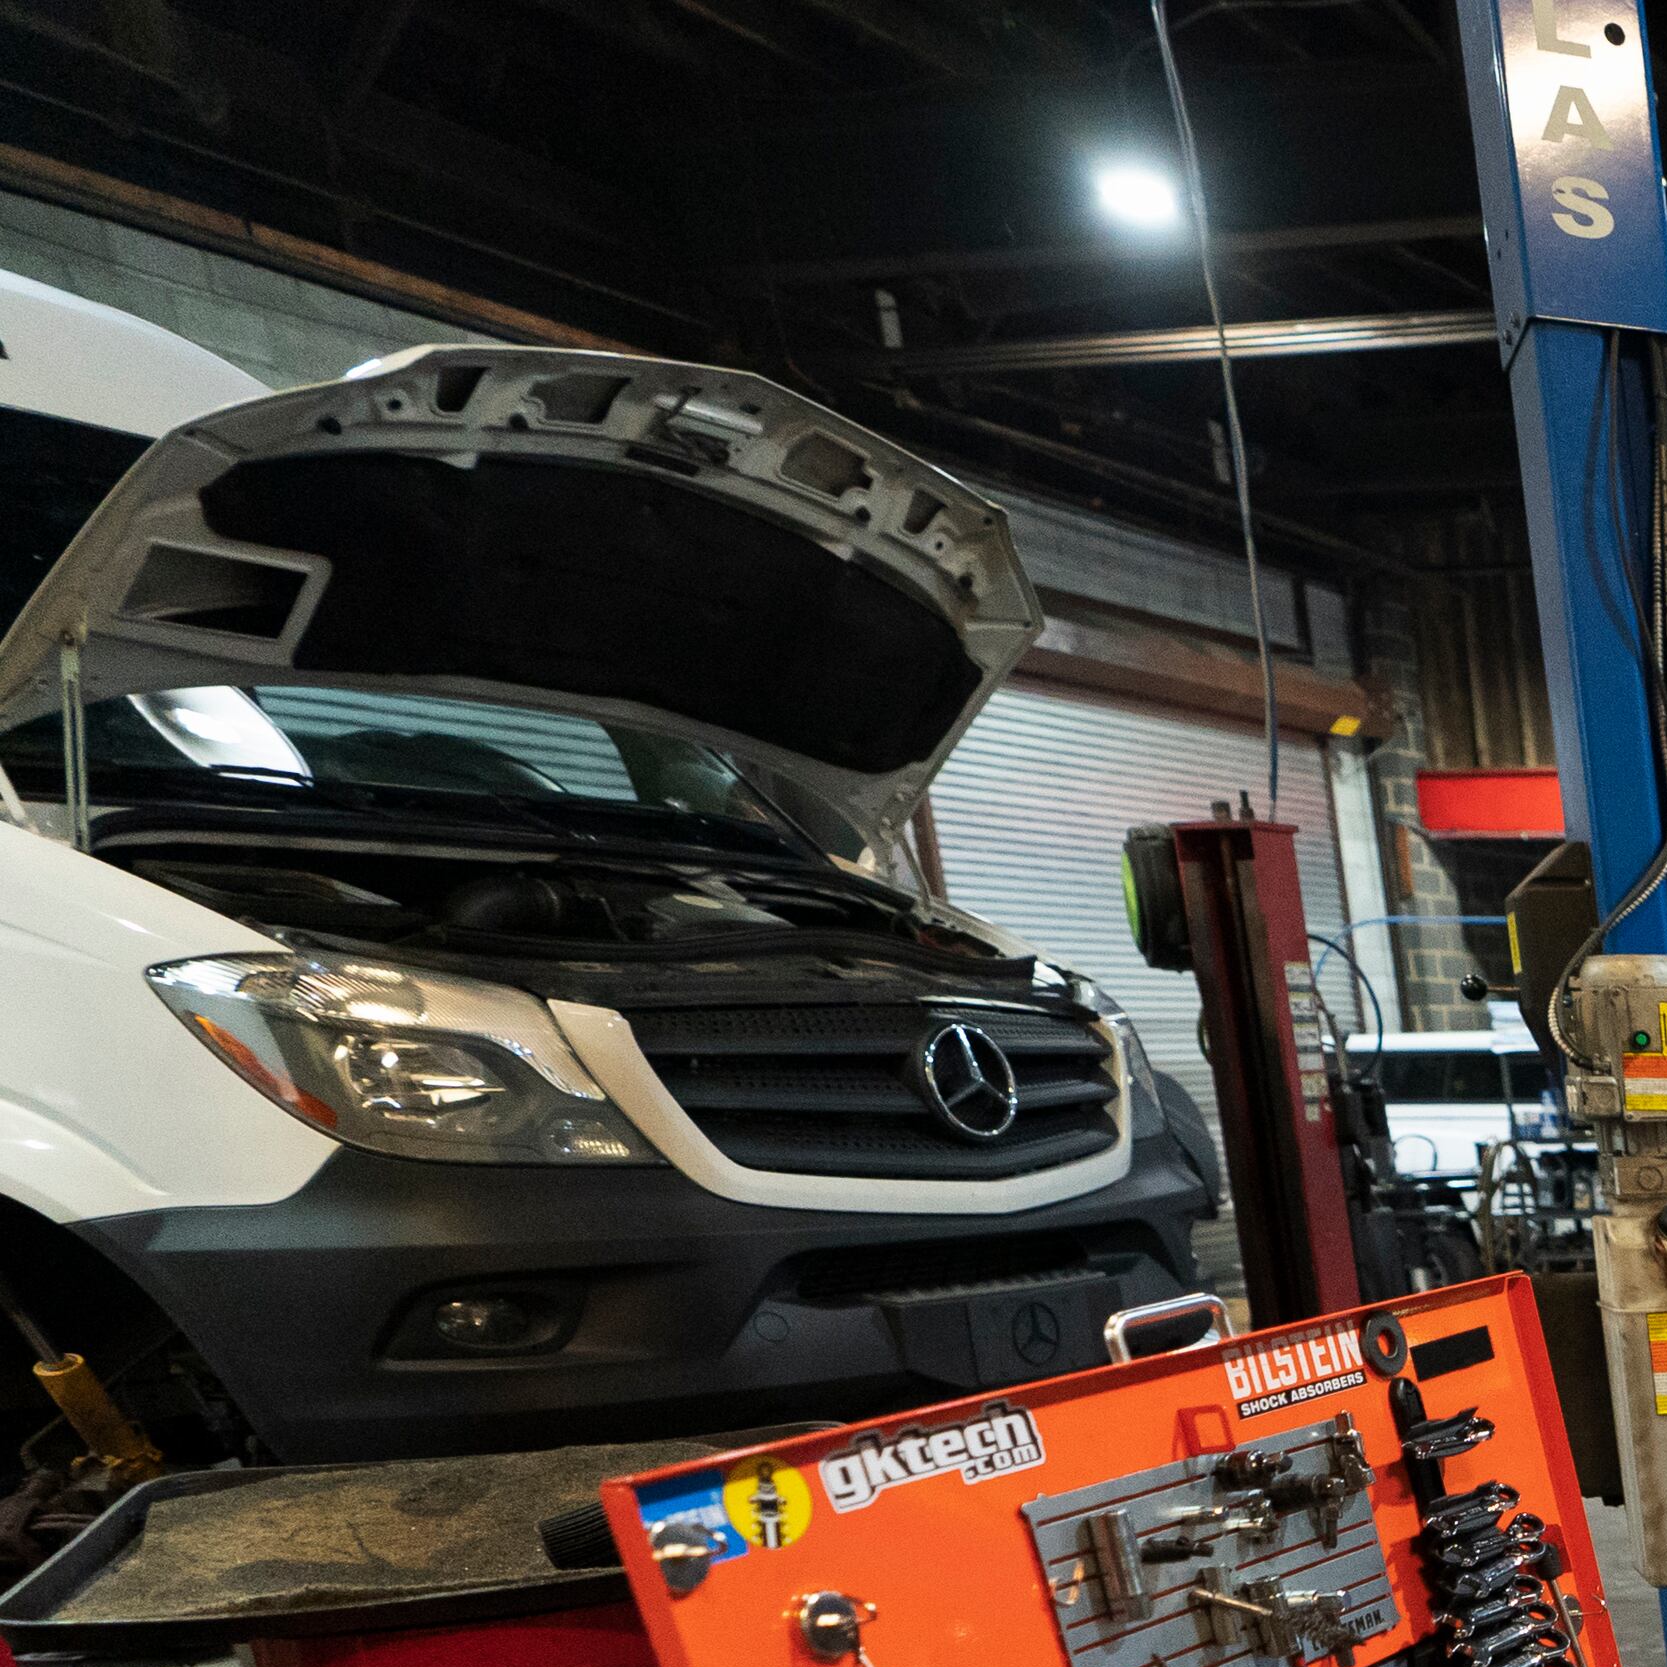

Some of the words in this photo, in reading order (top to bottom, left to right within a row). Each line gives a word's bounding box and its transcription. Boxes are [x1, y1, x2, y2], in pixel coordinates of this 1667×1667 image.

[1221, 1320, 1363, 1400] BILSTEIN
[1240, 1393, 1288, 1418] SHOCK
[1291, 1372, 1364, 1401] ABSORBERS
[825, 1402, 1034, 1501] gktech
[965, 1446, 1039, 1481] .com
